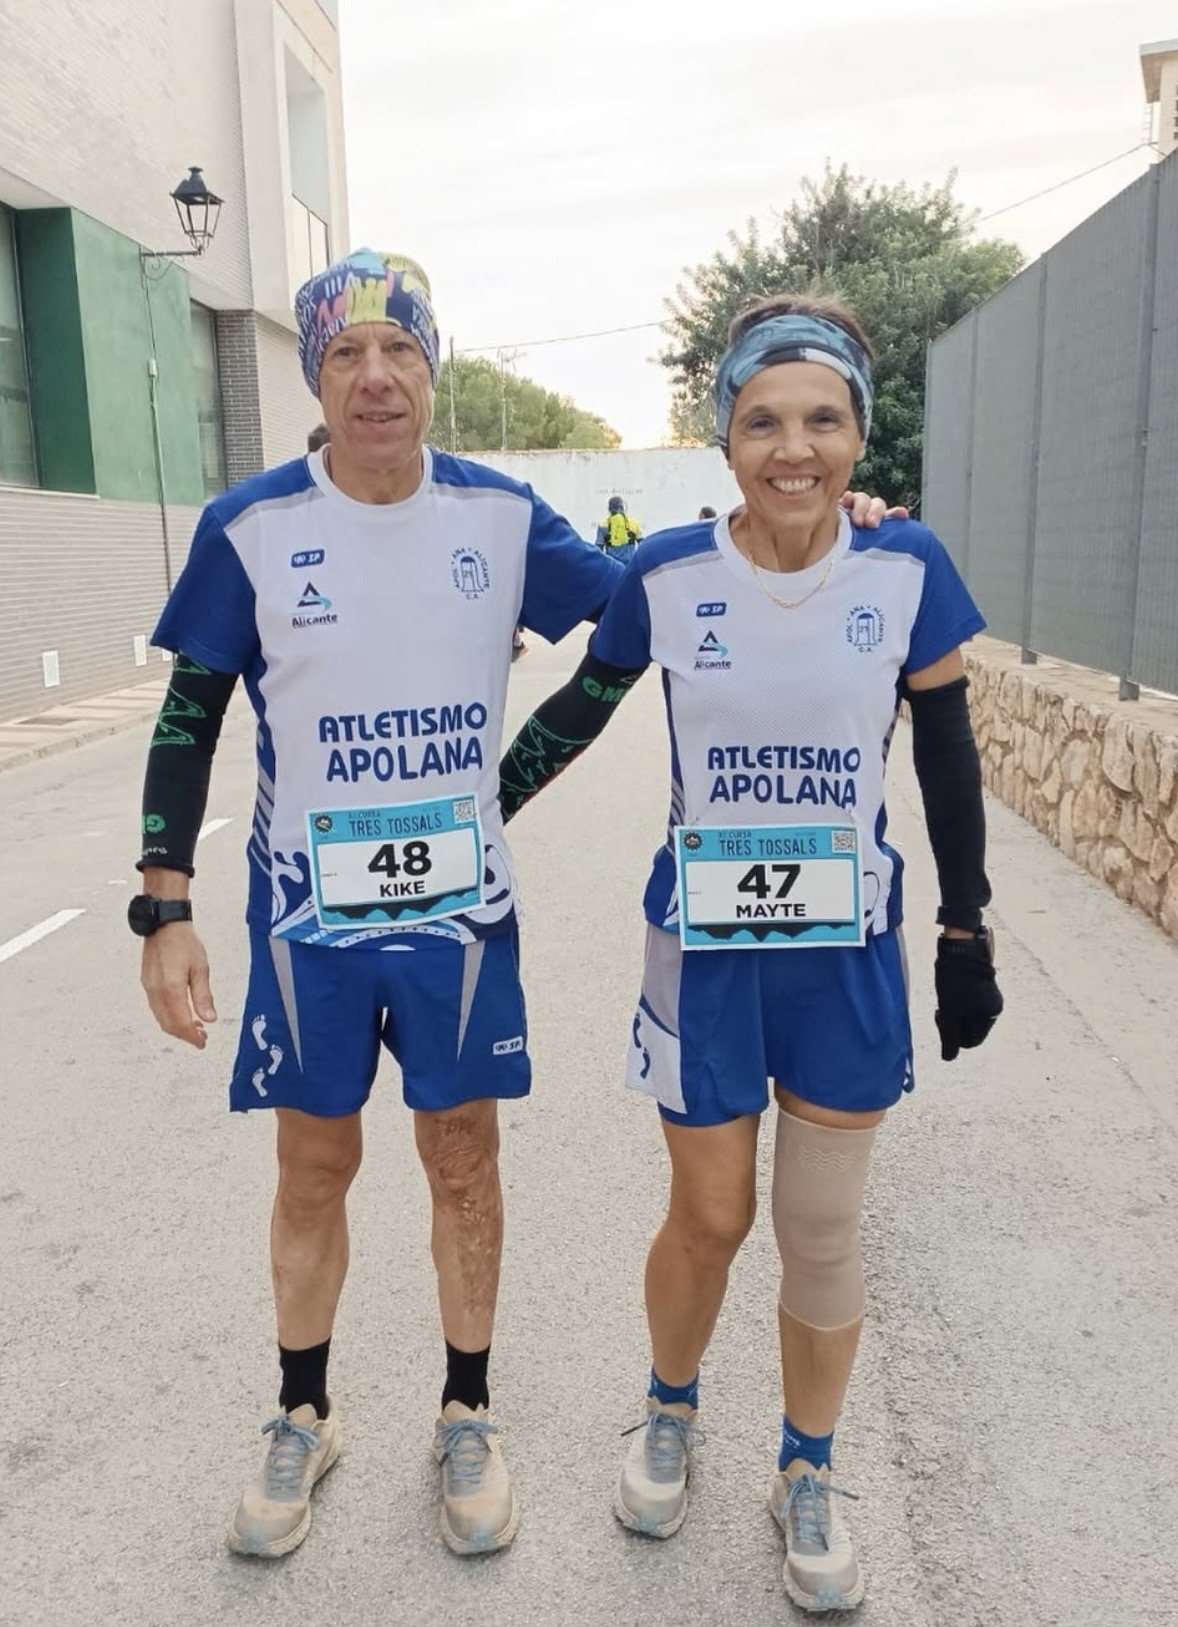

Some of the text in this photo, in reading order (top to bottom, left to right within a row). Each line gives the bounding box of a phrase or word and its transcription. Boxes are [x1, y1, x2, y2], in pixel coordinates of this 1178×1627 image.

[292, 613, 338, 628] Alicante
[694, 660, 731, 670] Alicante
[318, 702, 488, 743] ATLETISMO
[326, 736, 483, 783] APOLANA
[707, 746, 861, 774] ATLETISMO
[709, 774, 858, 809] APOLANA
[349, 812, 442, 837] TRES TOSSALS
[368, 841, 432, 878] 48
[719, 838, 817, 856] TRES TOSSALS
[379, 880, 426, 897] KIKE
[737, 864, 801, 899] 47
[736, 904, 806, 919] MAYTE
